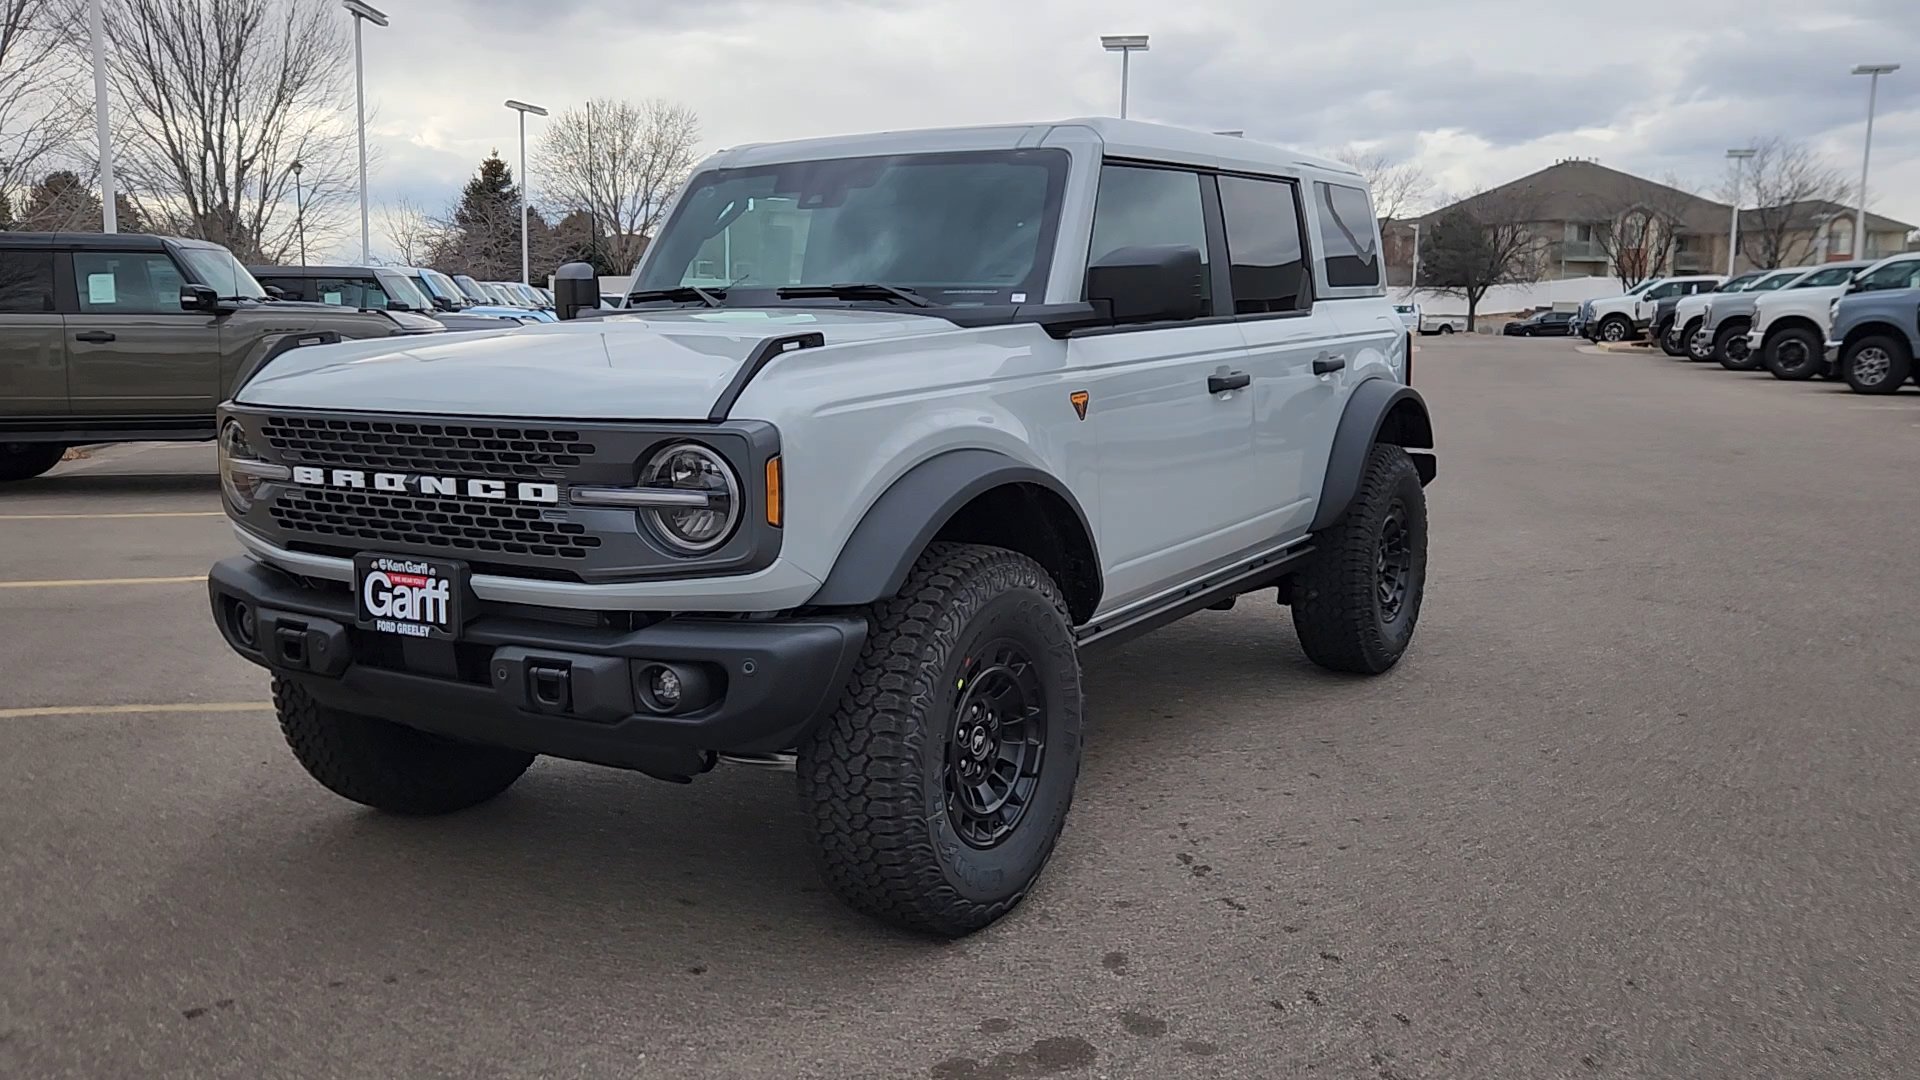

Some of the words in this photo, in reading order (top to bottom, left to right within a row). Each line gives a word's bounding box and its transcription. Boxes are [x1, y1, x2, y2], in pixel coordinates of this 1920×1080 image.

[293, 466, 558, 503] BRONCO
[386, 559, 405, 572] Ken
[405, 561, 428, 575] Garff
[364, 571, 450, 625] Garff
[377, 620, 396, 632] FORD
[397, 623, 430, 637] GREELEY
